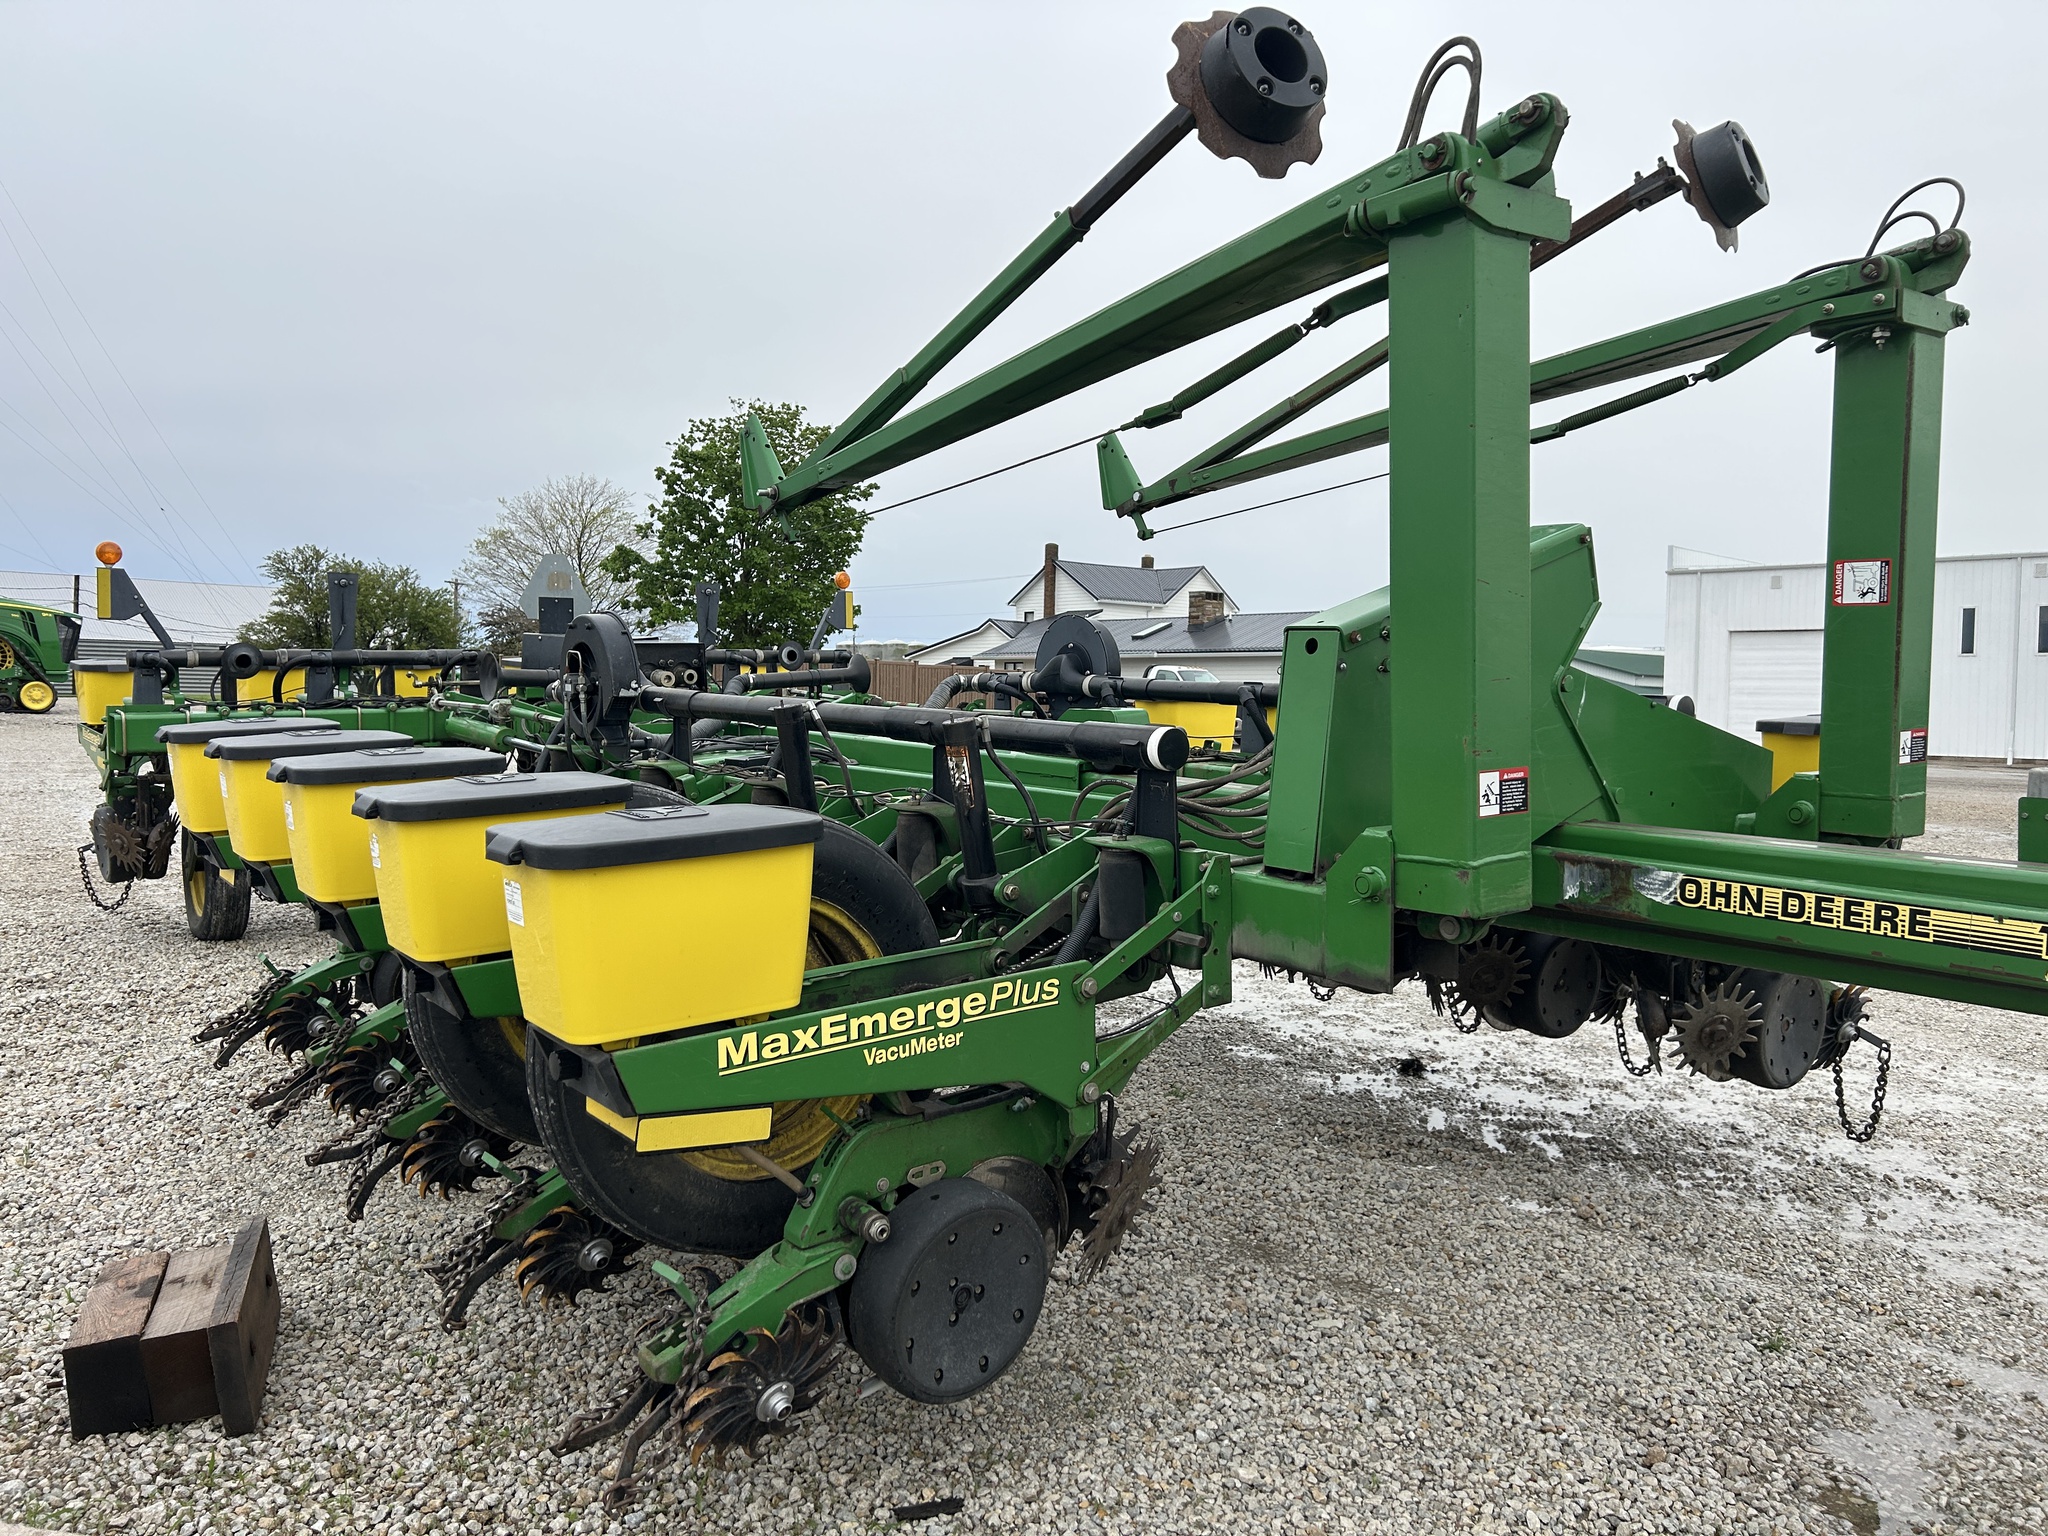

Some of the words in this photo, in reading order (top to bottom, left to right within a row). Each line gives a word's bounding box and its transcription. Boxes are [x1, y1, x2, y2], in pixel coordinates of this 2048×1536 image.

[1835, 563, 1843, 595] DANGER
[1678, 876, 1765, 917] OHN
[1777, 889, 1934, 942] DEERE
[863, 1031, 964, 1066] VacuMeter
